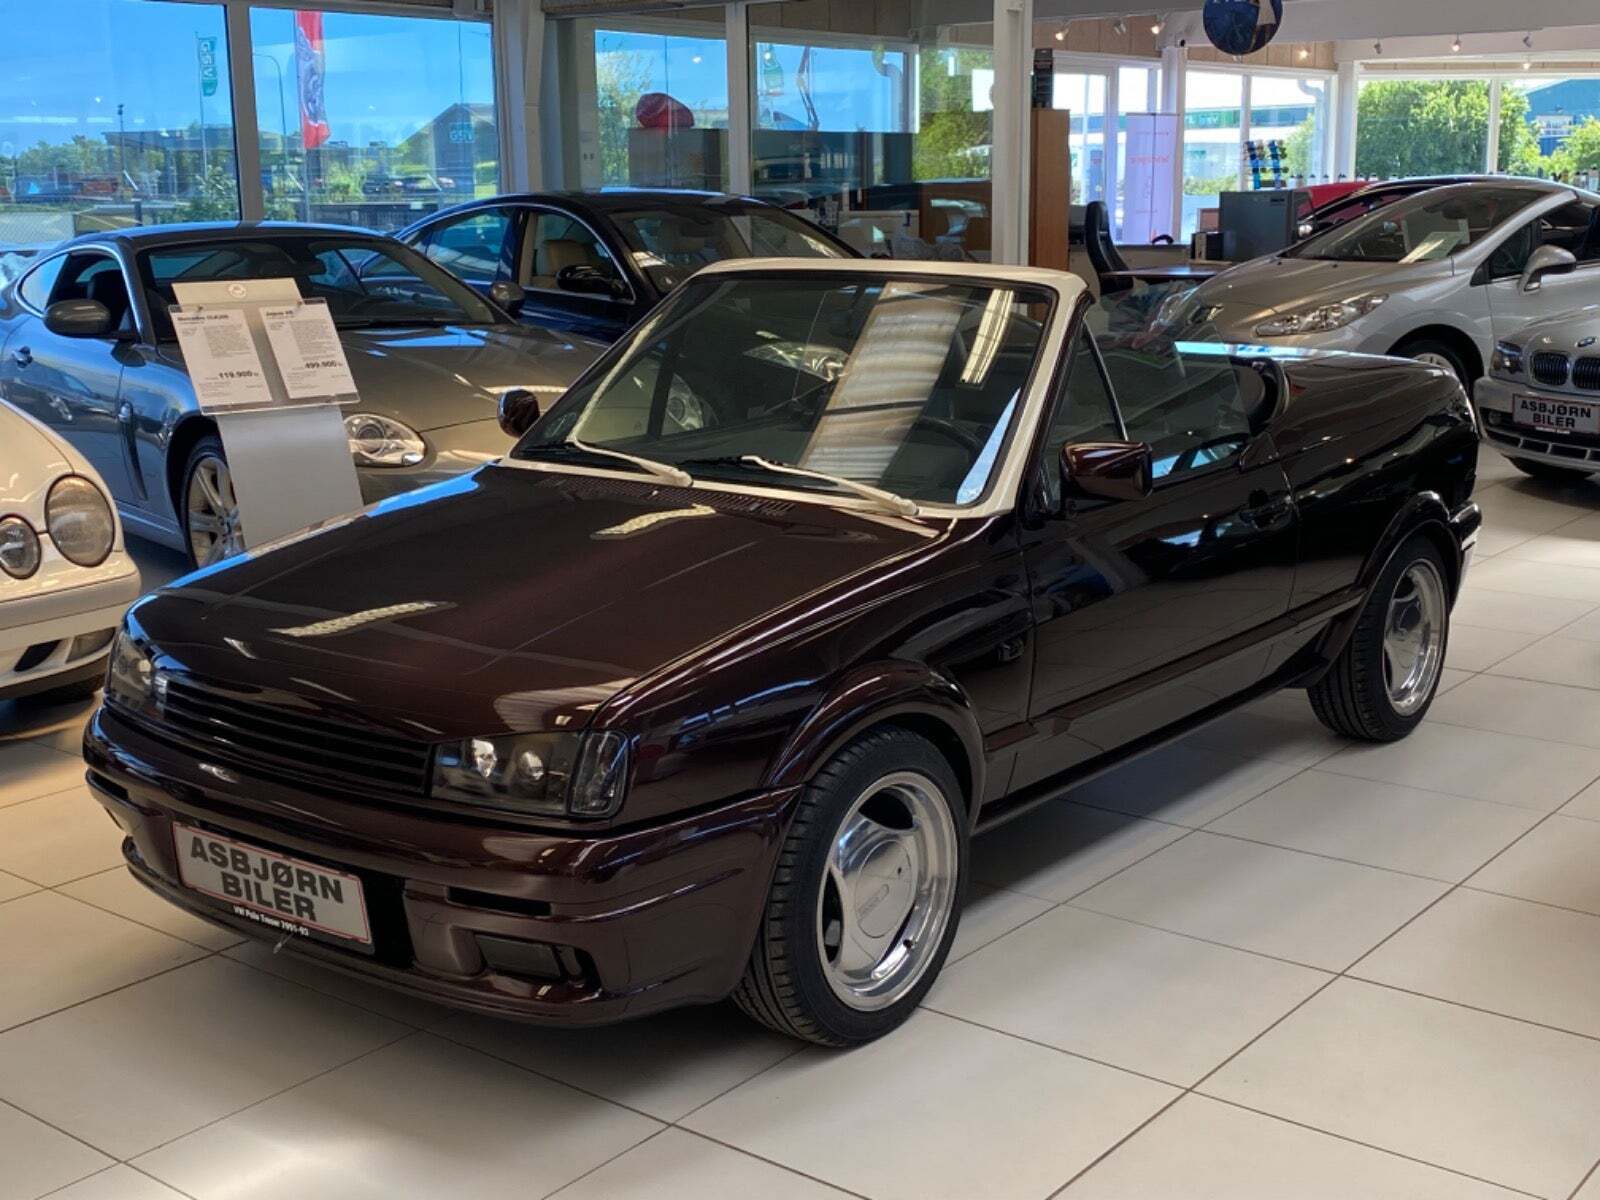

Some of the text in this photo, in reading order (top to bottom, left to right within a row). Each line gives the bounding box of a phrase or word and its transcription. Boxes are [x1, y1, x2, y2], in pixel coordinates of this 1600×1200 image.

[1533, 413, 1576, 428] BILER
[190, 836, 344, 904] ASBJØRN
[221, 871, 317, 922] BILER
